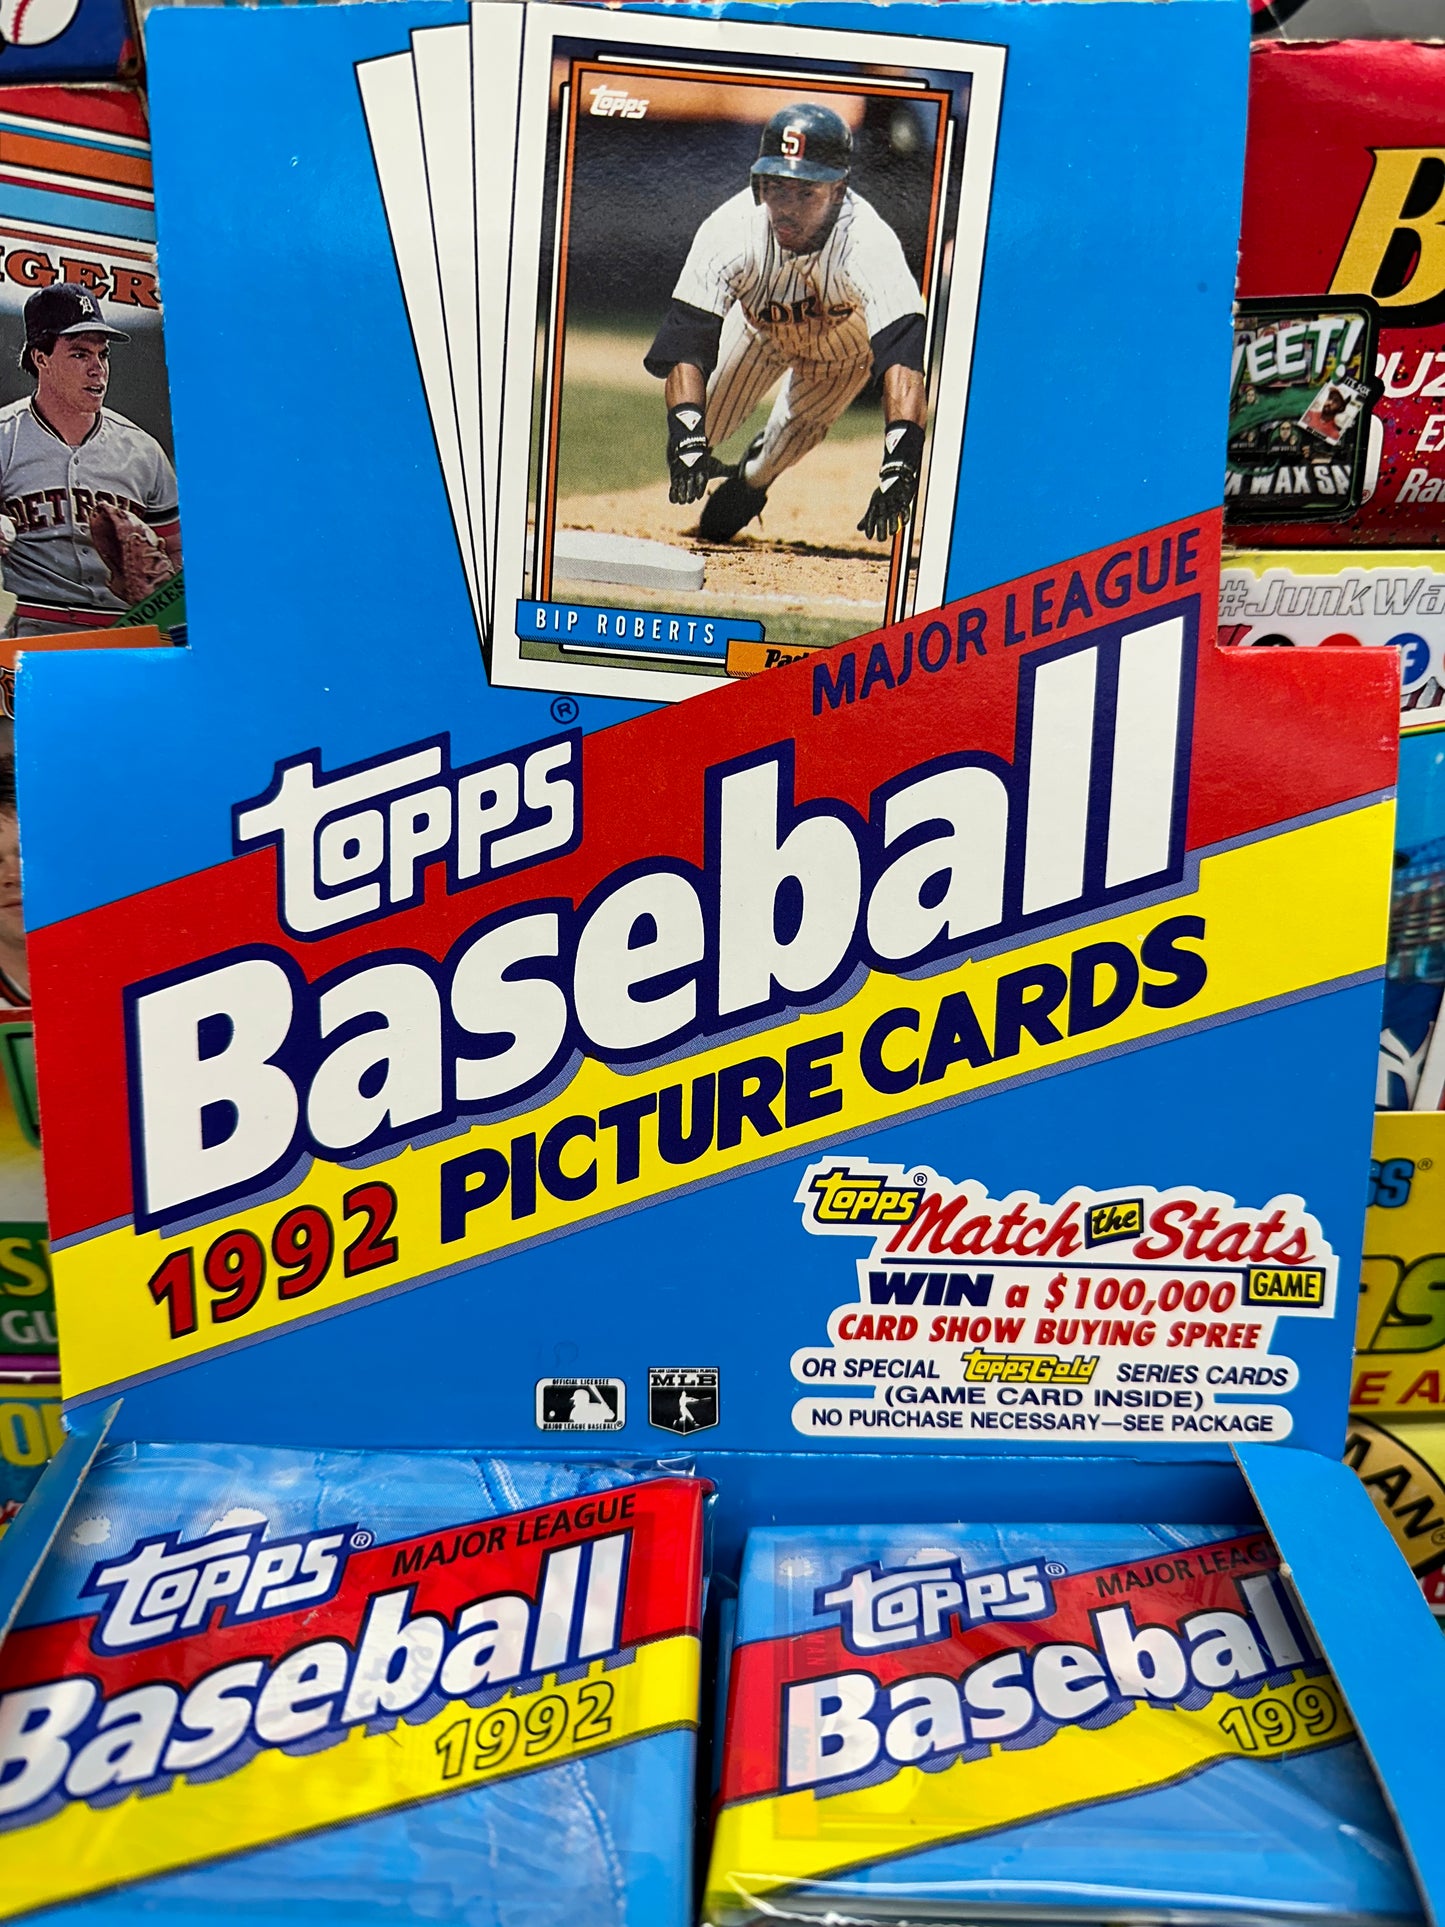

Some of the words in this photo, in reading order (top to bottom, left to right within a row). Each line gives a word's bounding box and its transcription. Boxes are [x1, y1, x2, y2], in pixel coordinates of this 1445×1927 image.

[0, 246, 162, 311] GER
[1394, 467, 1445, 503] Ra
[535, 607, 579, 630] BIP
[597, 613, 715, 645] ROBERTS
[811, 608, 989, 717] MAJOR
[1003, 527, 1201, 648] LEAGUE
[138, 608, 1194, 1226] Baseball
[147, 1180, 399, 1341] 1992
[439, 1031, 844, 1245] PICTURE
[859, 914, 1208, 1095] CARDS
[885, 1192, 1083, 1258] Match
[1092, 1206, 1138, 1235] the
[1132, 1199, 1317, 1265] Stats
[868, 1271, 995, 1307] WIN
[1004, 1284, 1030, 1308] a
[1043, 1271, 1236, 1316] $100,000
[1253, 1271, 1317, 1298] GAME
[837, 1313, 919, 1341] CARD
[928, 1315, 1026, 1344] SHOW
[1034, 1318, 1157, 1347] BUYING
[1166, 1321, 1262, 1349] SPREE
[651, 1374, 717, 1387] MLB
[802, 1357, 837, 1377] OR
[843, 1358, 940, 1379] SPECIAL
[1116, 1362, 1199, 1384] SERIES
[1205, 1365, 1289, 1387] CARDS
[884, 1385, 986, 1407] (GAME
[996, 1387, 1083, 1406] CARD
[1094, 1389, 1204, 1412] INSIDE)
[812, 1408, 843, 1426] NO
[849, 1409, 963, 1429] PURCHASE
[1171, 1414, 1274, 1433] PACKAGE
[391, 1526, 504, 1579] MAJOR
[515, 1493, 637, 1548] LEAGUE
[1096, 1553, 1195, 1599] MAJOR
[0, 1532, 632, 1818] Baseball
[435, 1680, 614, 1780] 1992
[1218, 1684, 1350, 1752] 199
